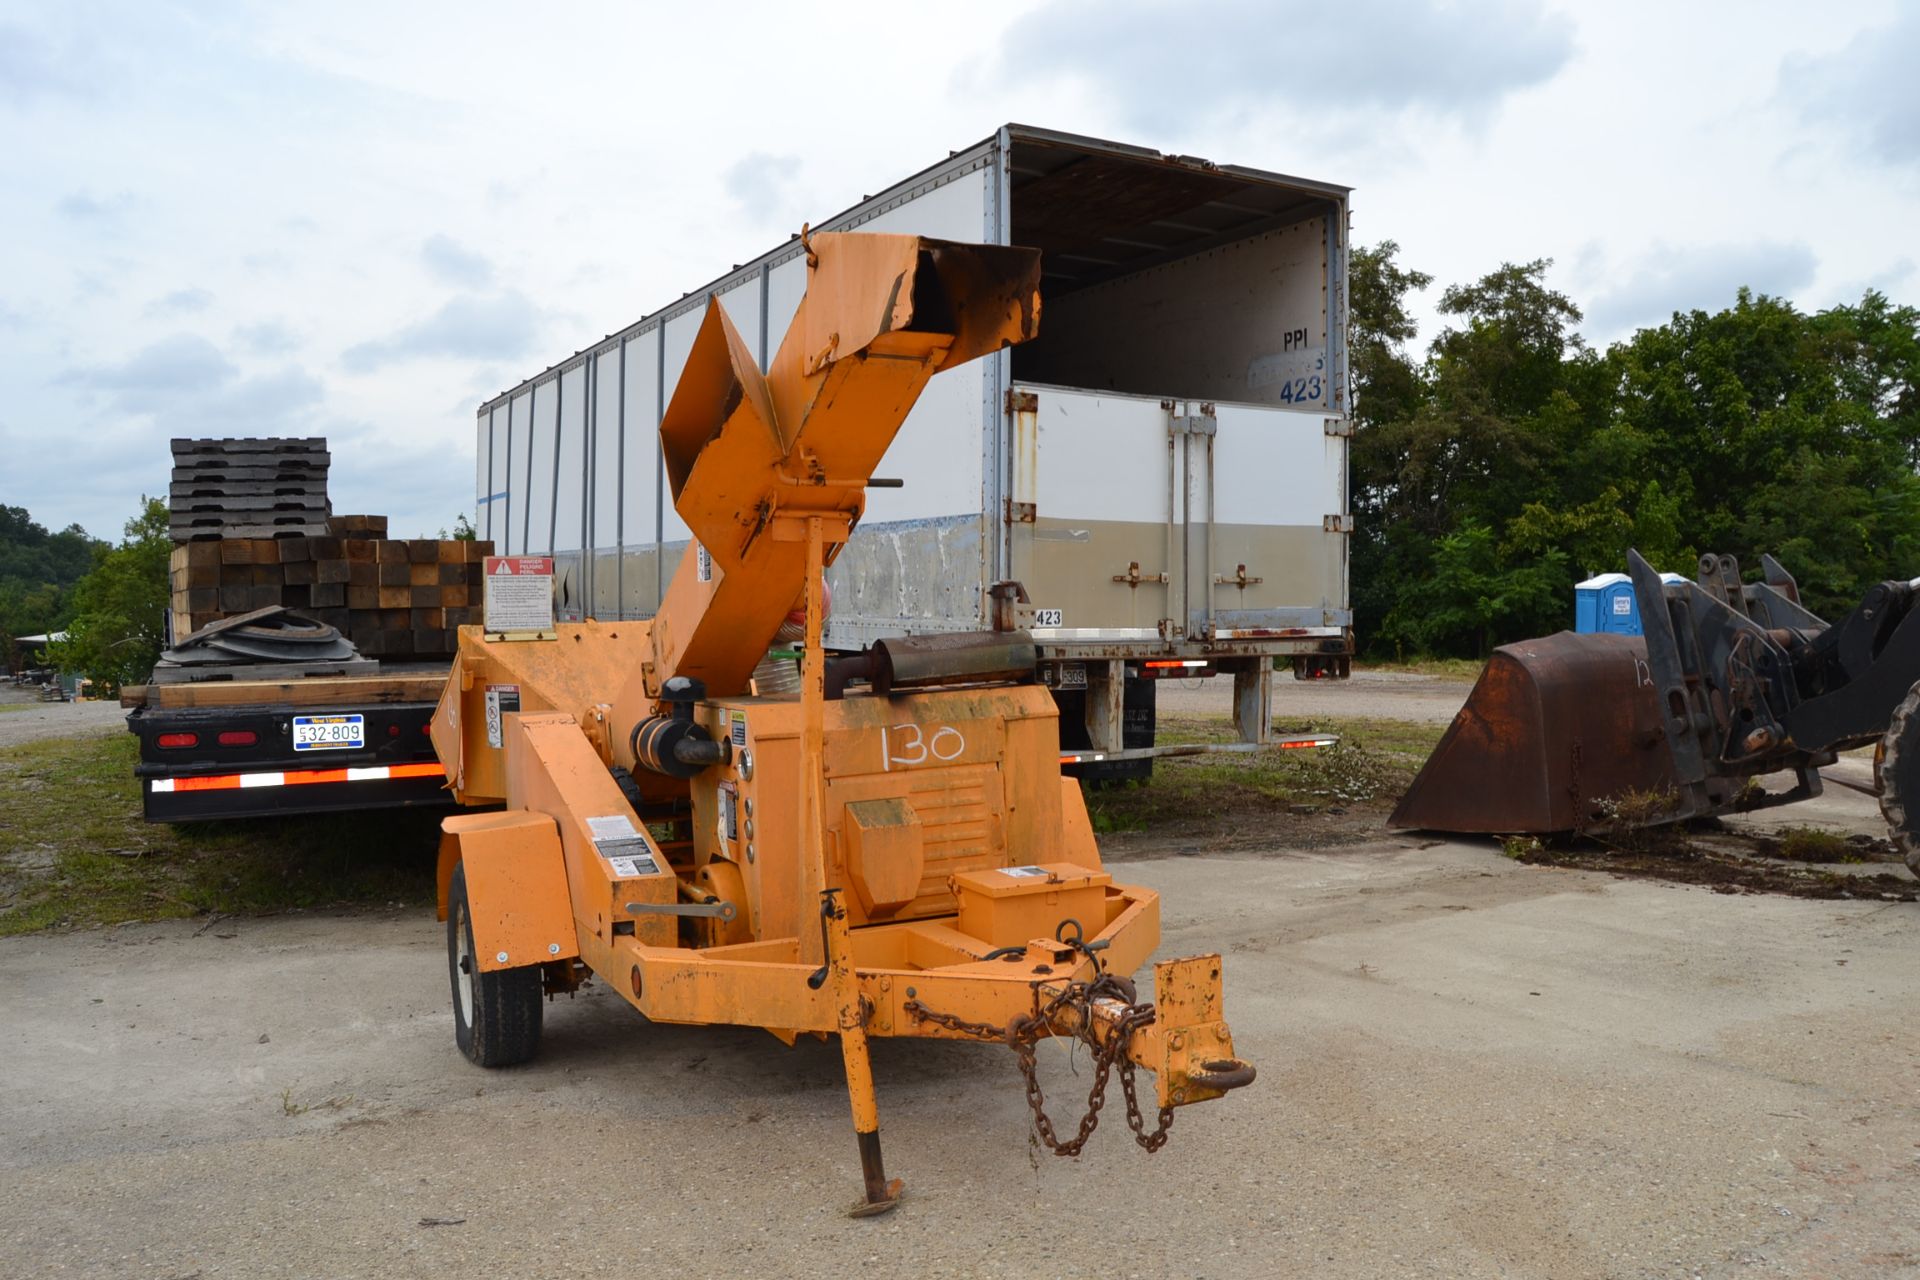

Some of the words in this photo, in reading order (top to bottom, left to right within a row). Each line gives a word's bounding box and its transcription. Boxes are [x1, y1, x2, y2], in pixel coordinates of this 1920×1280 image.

[1284, 327, 1308, 352] PPI
[1280, 375, 1322, 404] 423
[1036, 610, 1062, 625] 423
[308, 725, 360, 741] 32-809
[881, 723, 965, 772] 130
